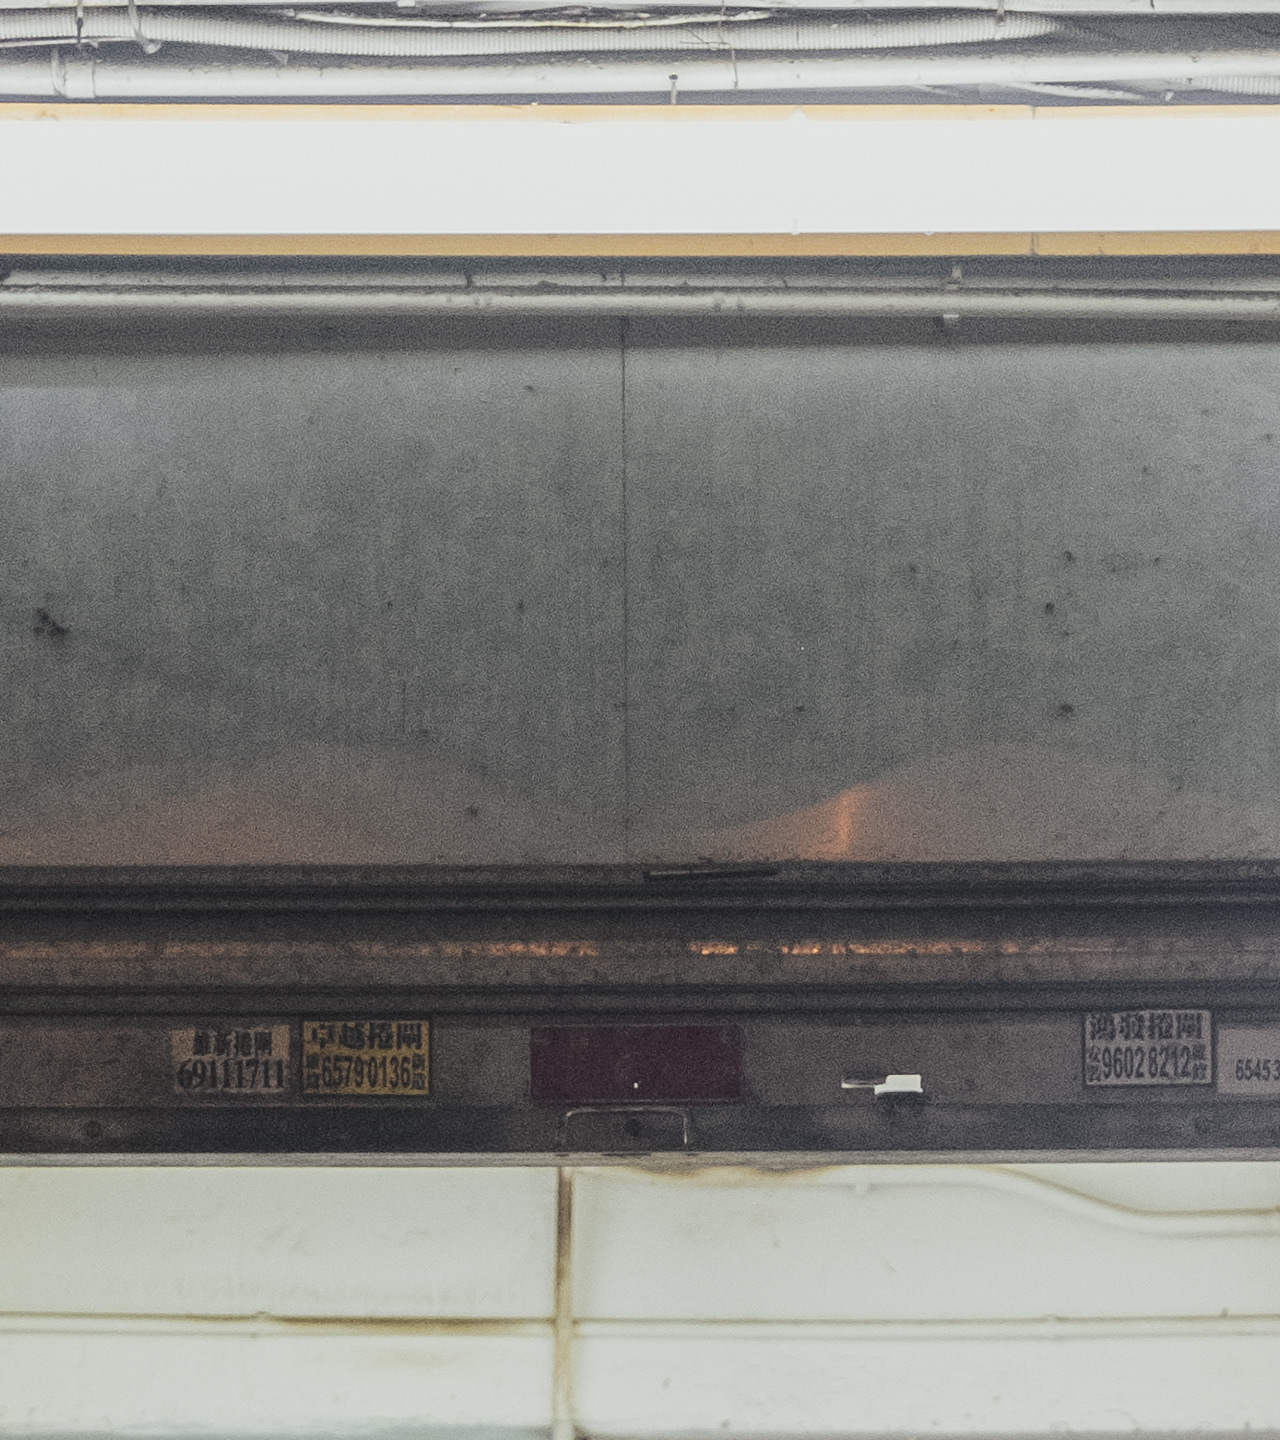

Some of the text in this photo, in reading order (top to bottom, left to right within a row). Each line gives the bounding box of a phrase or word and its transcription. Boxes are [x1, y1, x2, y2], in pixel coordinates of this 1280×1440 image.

[1102, 1044, 1191, 1079] 9602 8212
[1235, 1059, 1271, 1081] 6545
